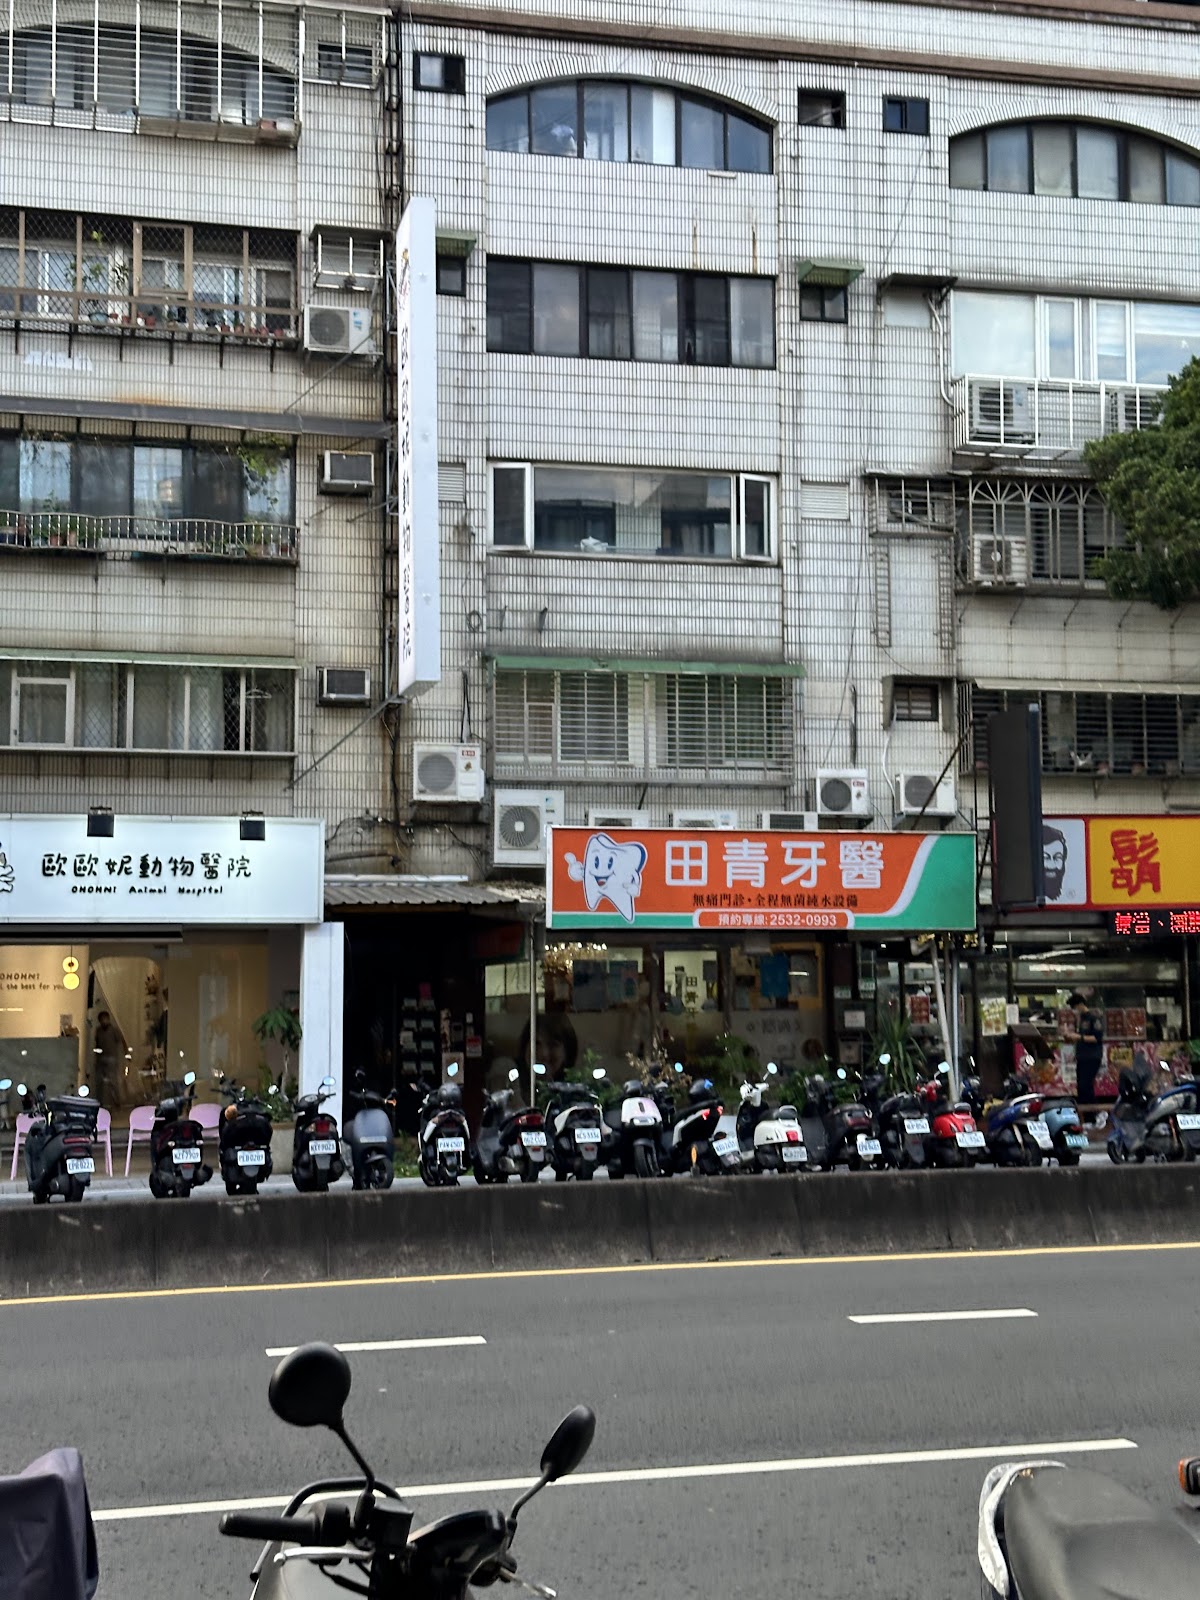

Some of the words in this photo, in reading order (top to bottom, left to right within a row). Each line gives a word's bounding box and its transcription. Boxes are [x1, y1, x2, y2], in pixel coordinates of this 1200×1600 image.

[42, 852, 251, 879] 歐歐妮動物醫院
[665, 838, 884, 889] 田青牙醫
[129, 885, 167, 894] Animal
[178, 885, 223, 897] Hospital
[40, 982, 50, 990] for
